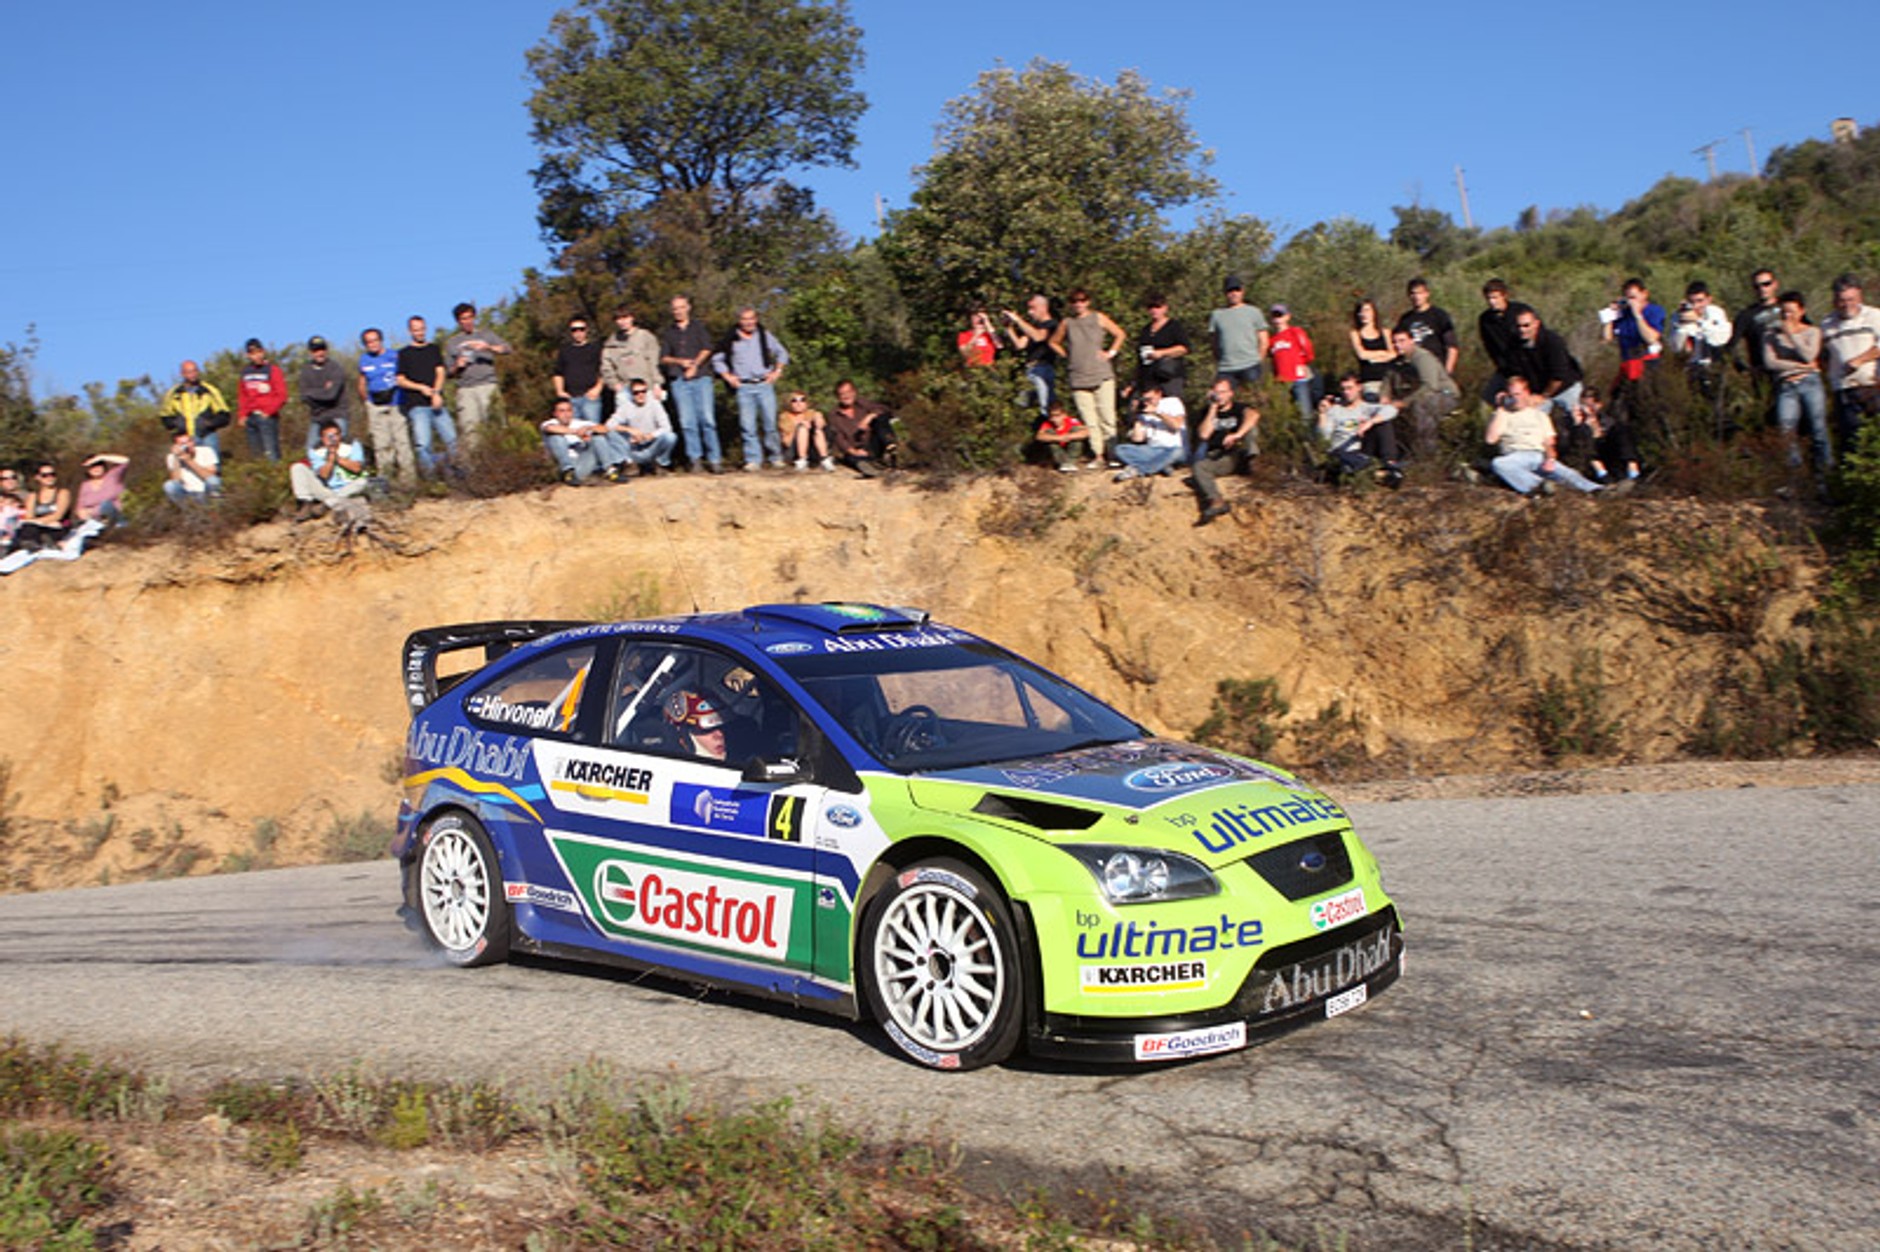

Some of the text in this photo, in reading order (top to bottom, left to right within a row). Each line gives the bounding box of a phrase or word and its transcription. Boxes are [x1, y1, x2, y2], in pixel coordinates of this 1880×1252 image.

[823, 638, 882, 653] Abu
[479, 695, 556, 730] Hirvonen
[450, 726, 531, 781] Dhabi
[564, 758, 654, 792] KÄRCHER
[775, 796, 796, 840] 4
[1166, 813, 1197, 829] bp
[1192, 794, 1347, 854] ultimate
[639, 873, 778, 948] Castrol
[1076, 909, 1100, 929] bp
[1326, 892, 1365, 925] Castrol
[1077, 914, 1264, 959] ultimate
[1099, 961, 1206, 984] KÄRCHER
[1259, 963, 1331, 1014] Abu
[1141, 1027, 1241, 1053] BFGoodrich
